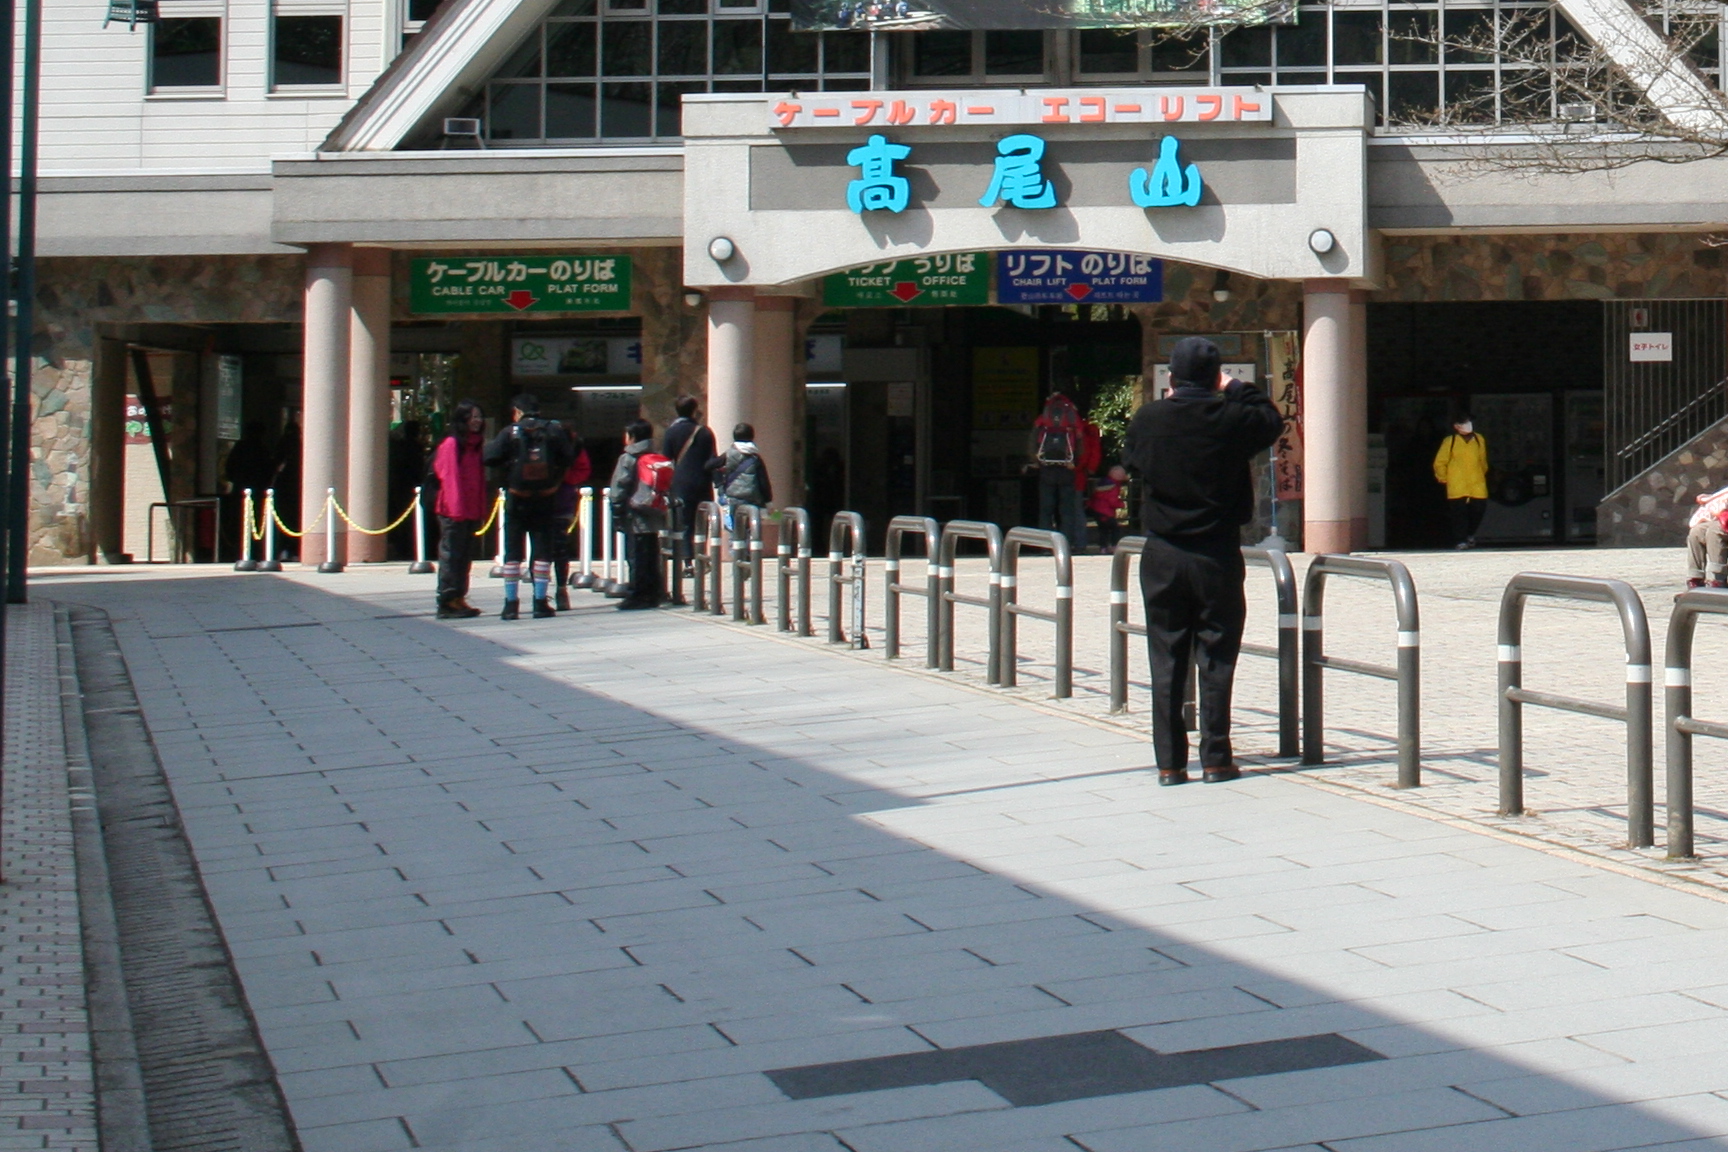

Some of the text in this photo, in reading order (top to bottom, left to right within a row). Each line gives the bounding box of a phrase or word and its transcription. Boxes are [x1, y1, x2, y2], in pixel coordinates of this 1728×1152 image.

[426, 259, 616, 283] ケーブルカーのりば
[1007, 254, 1074, 277] リフト
[848, 275, 967, 286] TICKET OFFICE
[1012, 276, 1148, 287] CHAIR LIFT PLAT FORM
[432, 283, 619, 296] CABLE CAR PLAT FORM
[1632, 342, 1669, 352] 女子トイレ
